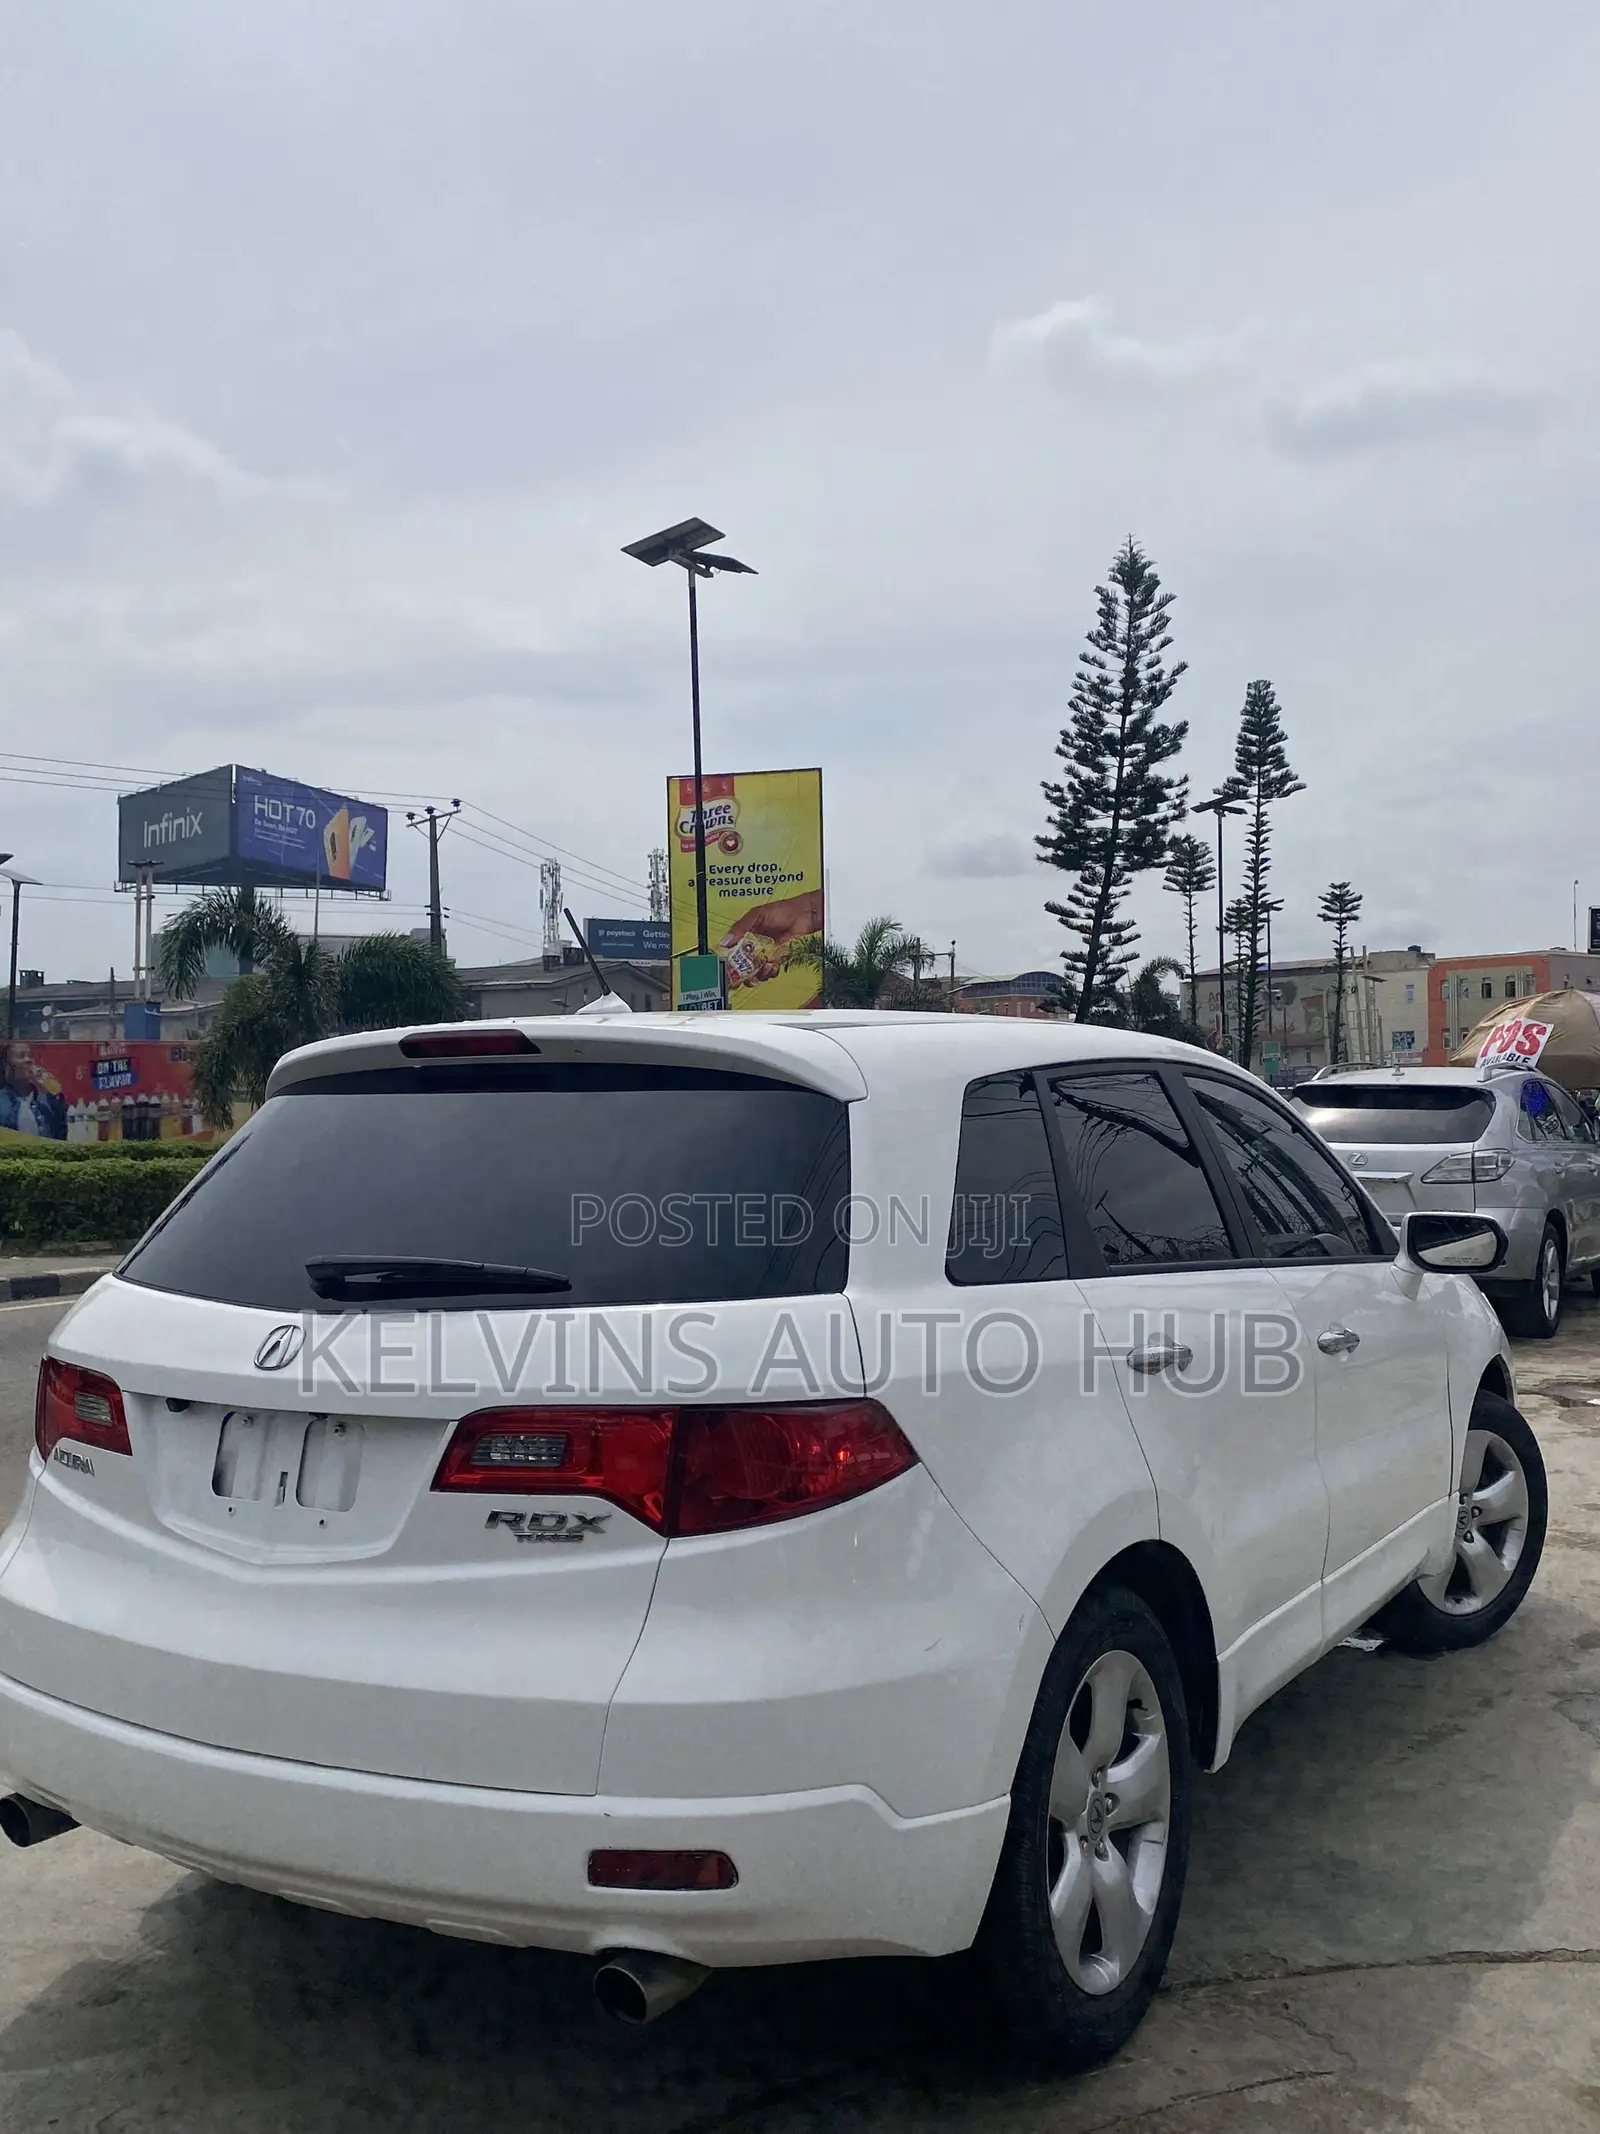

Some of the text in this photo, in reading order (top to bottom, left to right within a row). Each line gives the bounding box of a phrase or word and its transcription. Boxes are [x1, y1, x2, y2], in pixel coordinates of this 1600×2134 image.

[254, 795, 316, 829] HOT 70
[144, 807, 203, 848] Infinix
[679, 815, 734, 834] Crwns
[709, 862, 782, 875] Every drop,
[688, 871, 804, 887] a easure beyond
[719, 887, 774, 898] measure
[643, 941, 657, 950] We
[1480, 1020, 1548, 1057] POS
[485, 1508, 613, 1534] RDX
